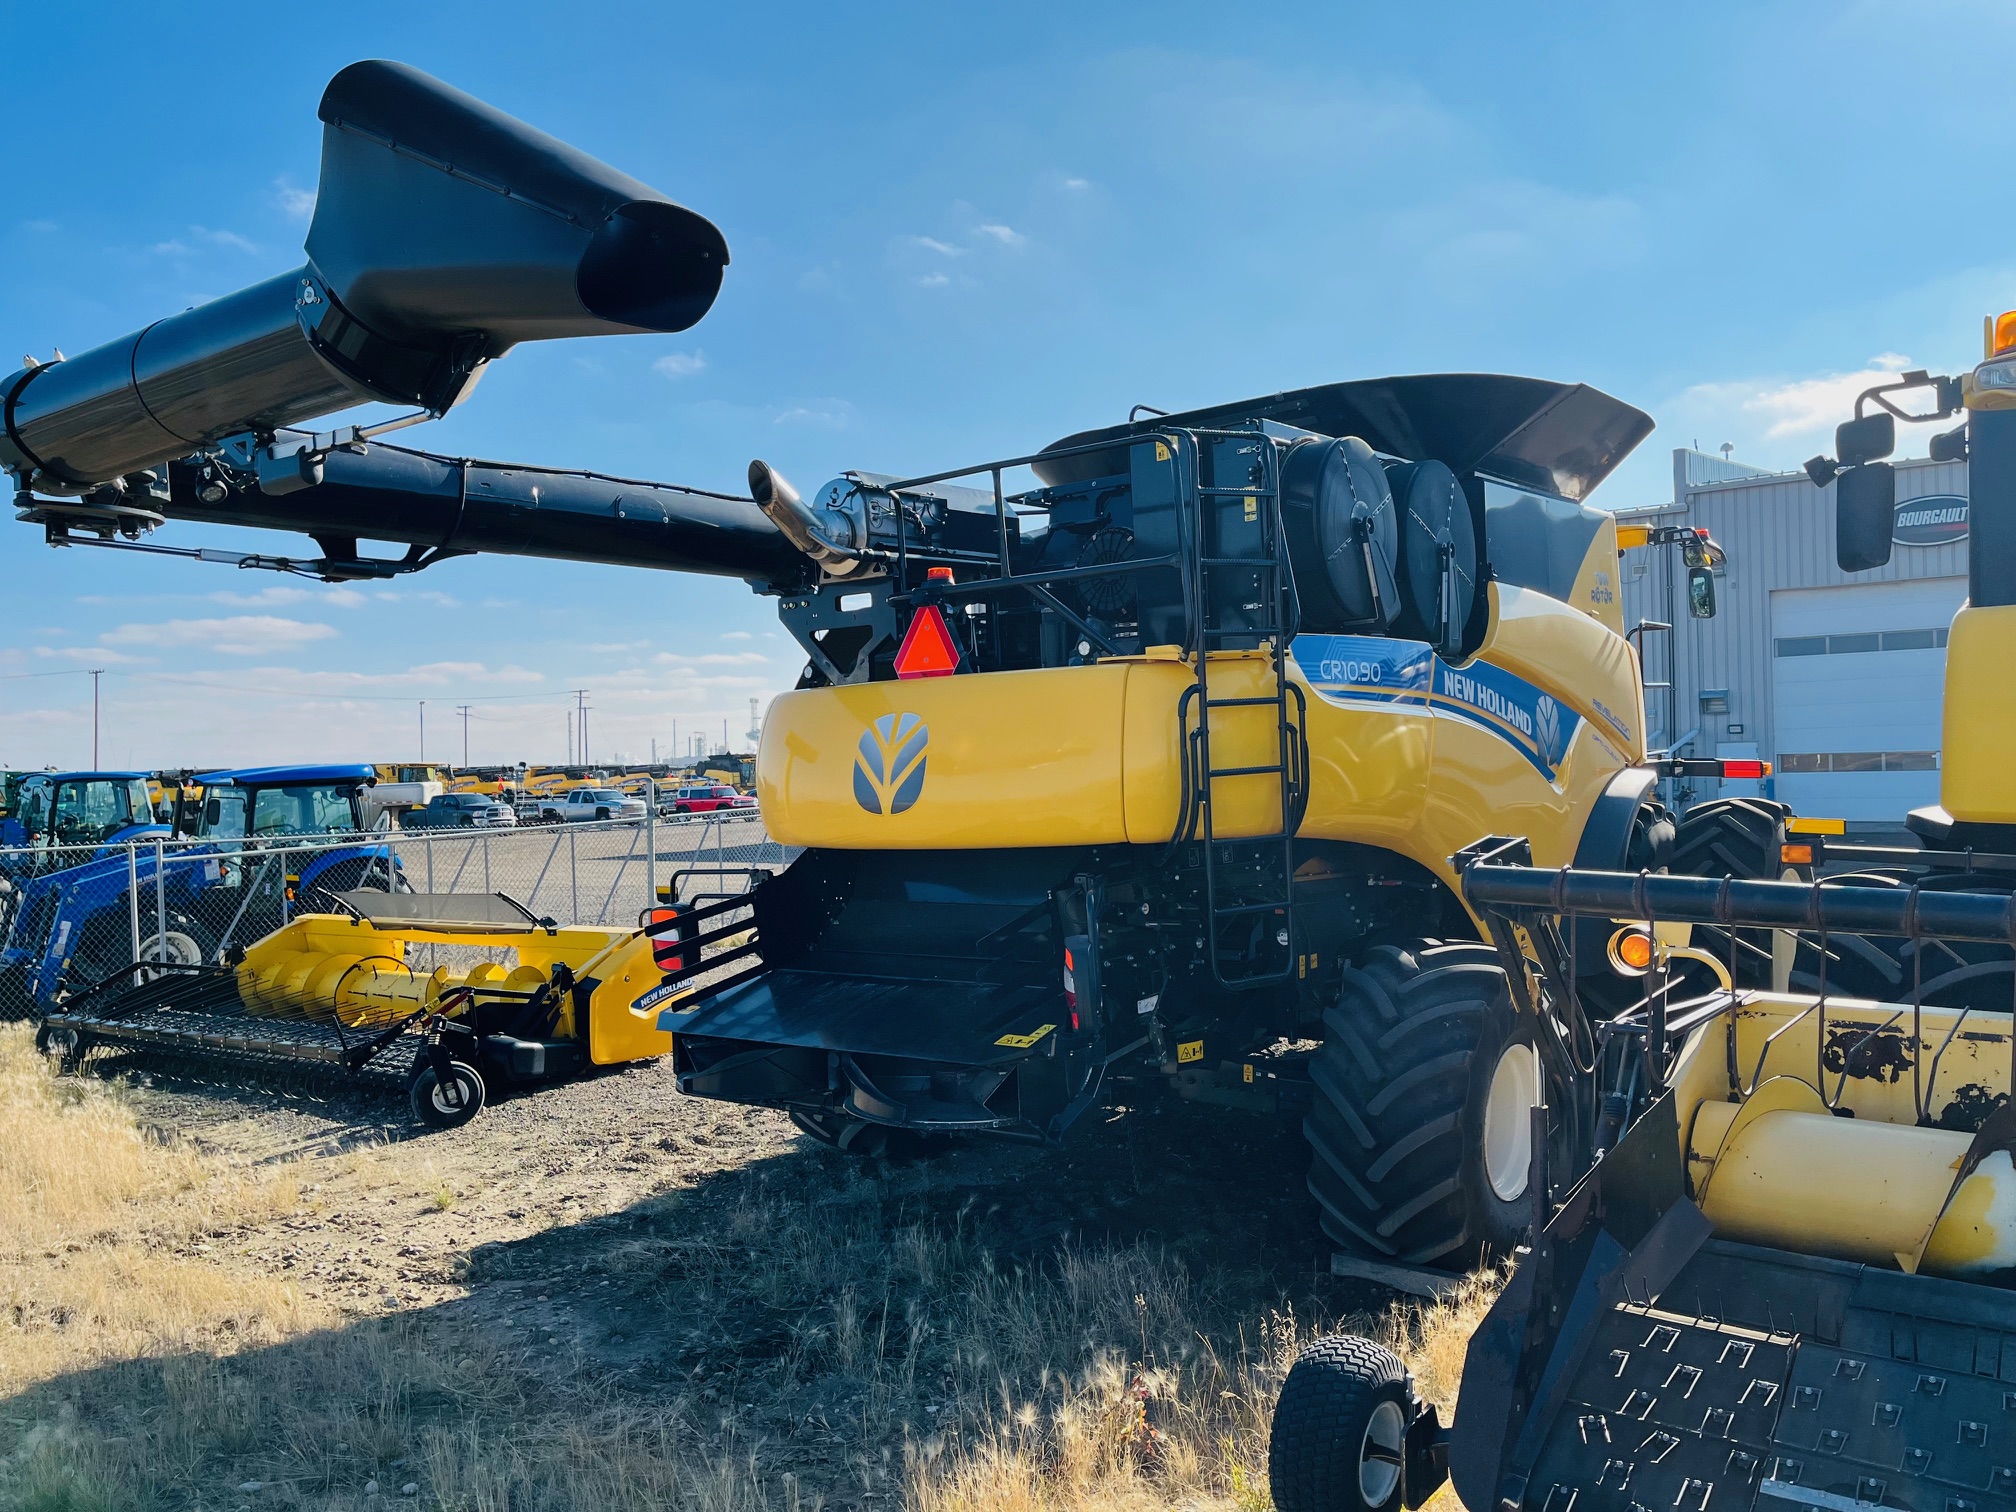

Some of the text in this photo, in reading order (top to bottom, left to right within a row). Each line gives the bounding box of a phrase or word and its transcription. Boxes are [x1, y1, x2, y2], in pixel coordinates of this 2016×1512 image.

[1897, 506, 1968, 527] BOURGAULT
[1320, 659, 1381, 682] CR10.90
[1443, 670, 1532, 736] NEW HOLLAND
[640, 978, 694, 1008] NEW HOLLAND
